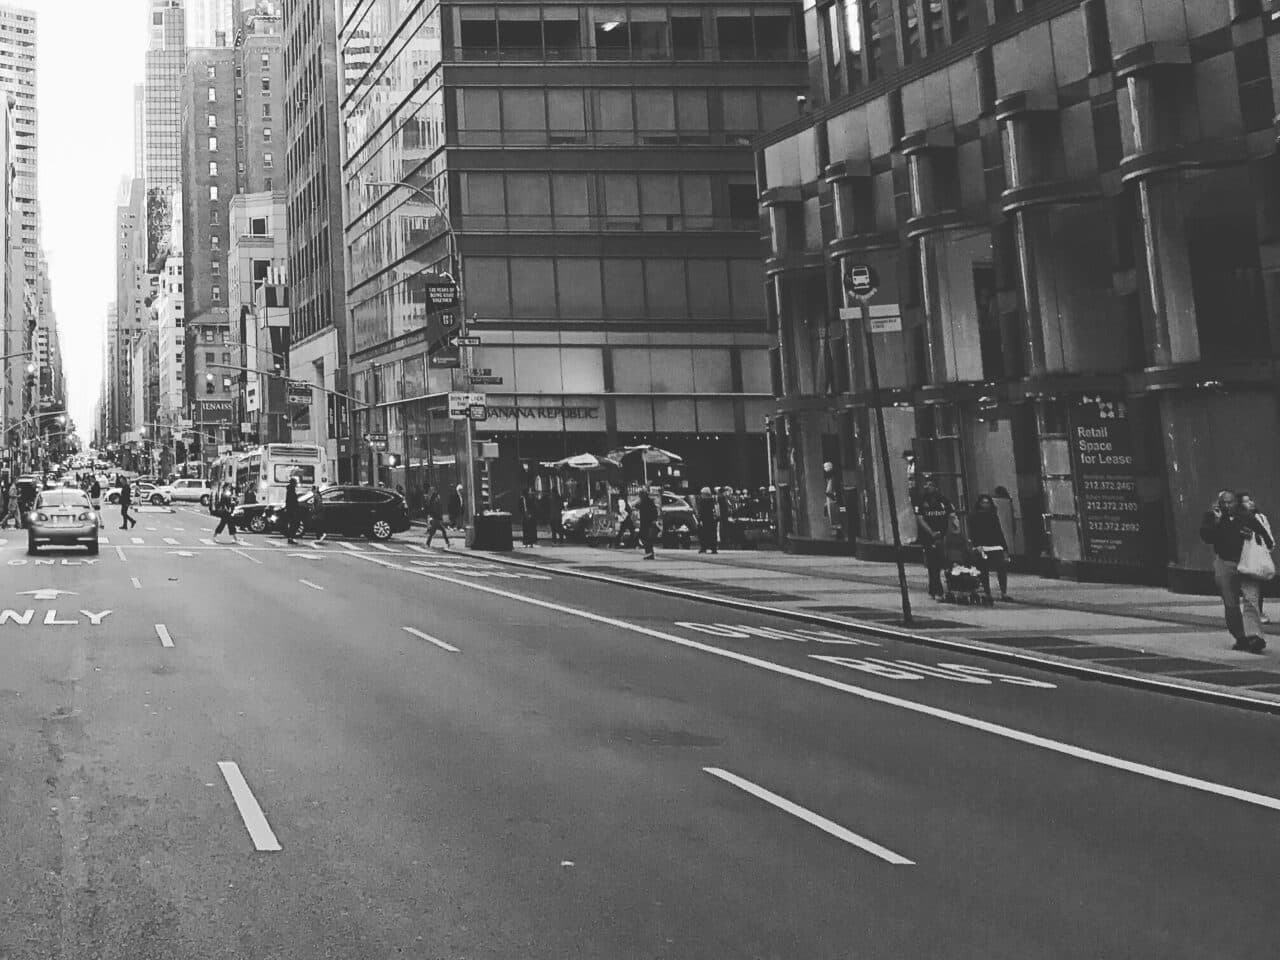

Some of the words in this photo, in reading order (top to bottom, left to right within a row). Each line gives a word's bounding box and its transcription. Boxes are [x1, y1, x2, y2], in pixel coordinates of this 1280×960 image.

[538, 407, 599, 419] REPUBLIC
[1077, 426, 1108, 438] Retail
[1078, 439, 1113, 453] Space
[1080, 453, 1096, 464] for
[1098, 453, 1133, 465] Lease
